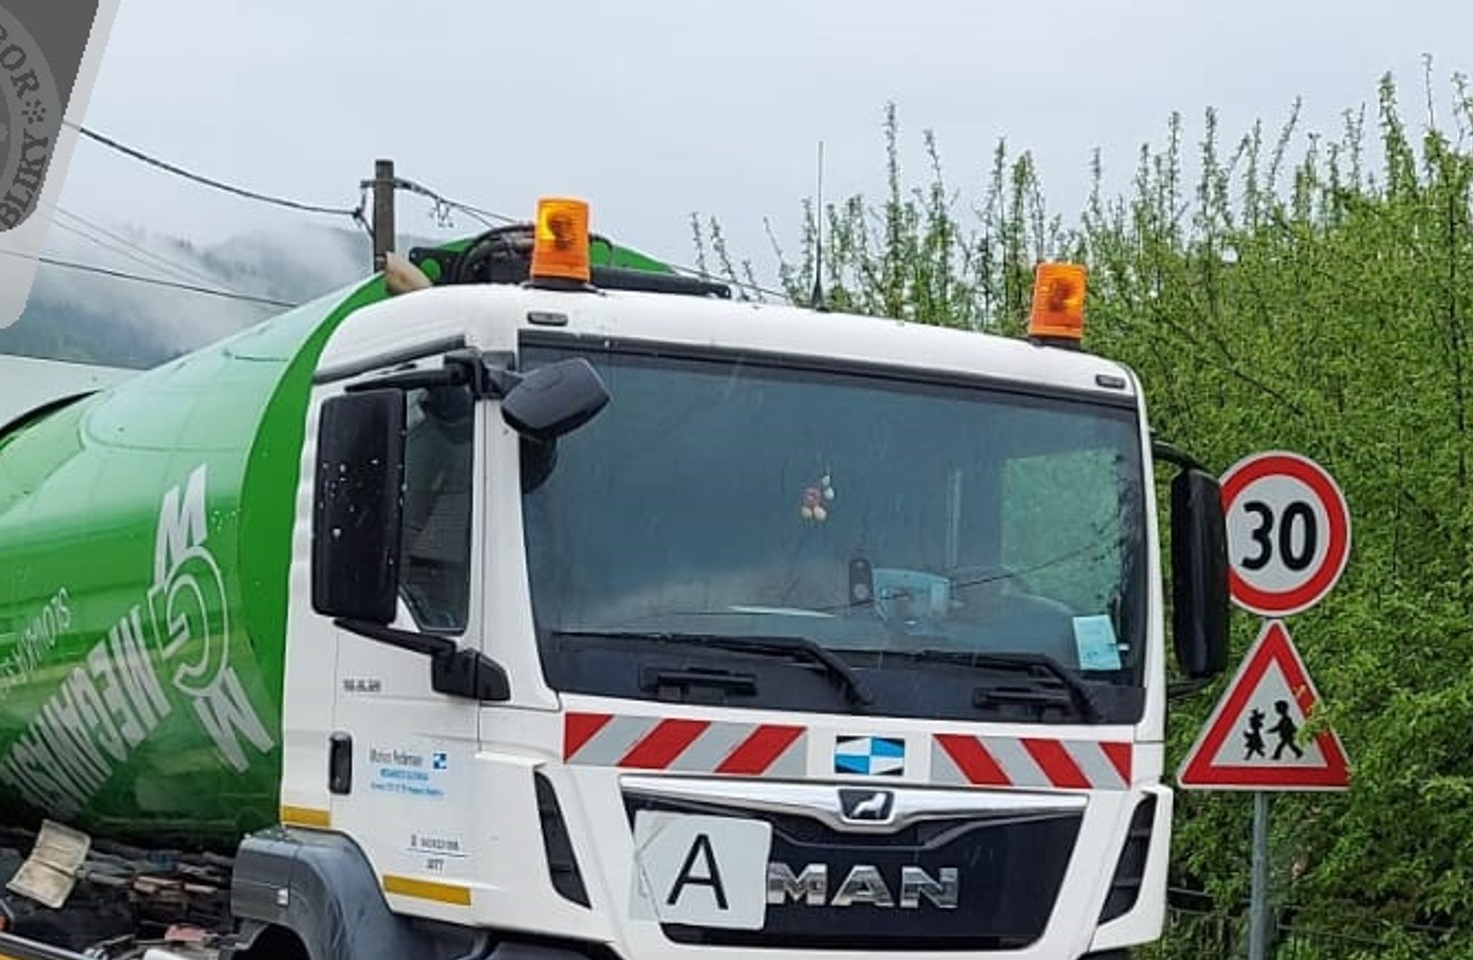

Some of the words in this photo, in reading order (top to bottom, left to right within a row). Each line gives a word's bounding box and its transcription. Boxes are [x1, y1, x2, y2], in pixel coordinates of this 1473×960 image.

[1240, 500, 1318, 572] 30
[665, 832, 729, 911] A
[765, 862, 959, 909] MAN
